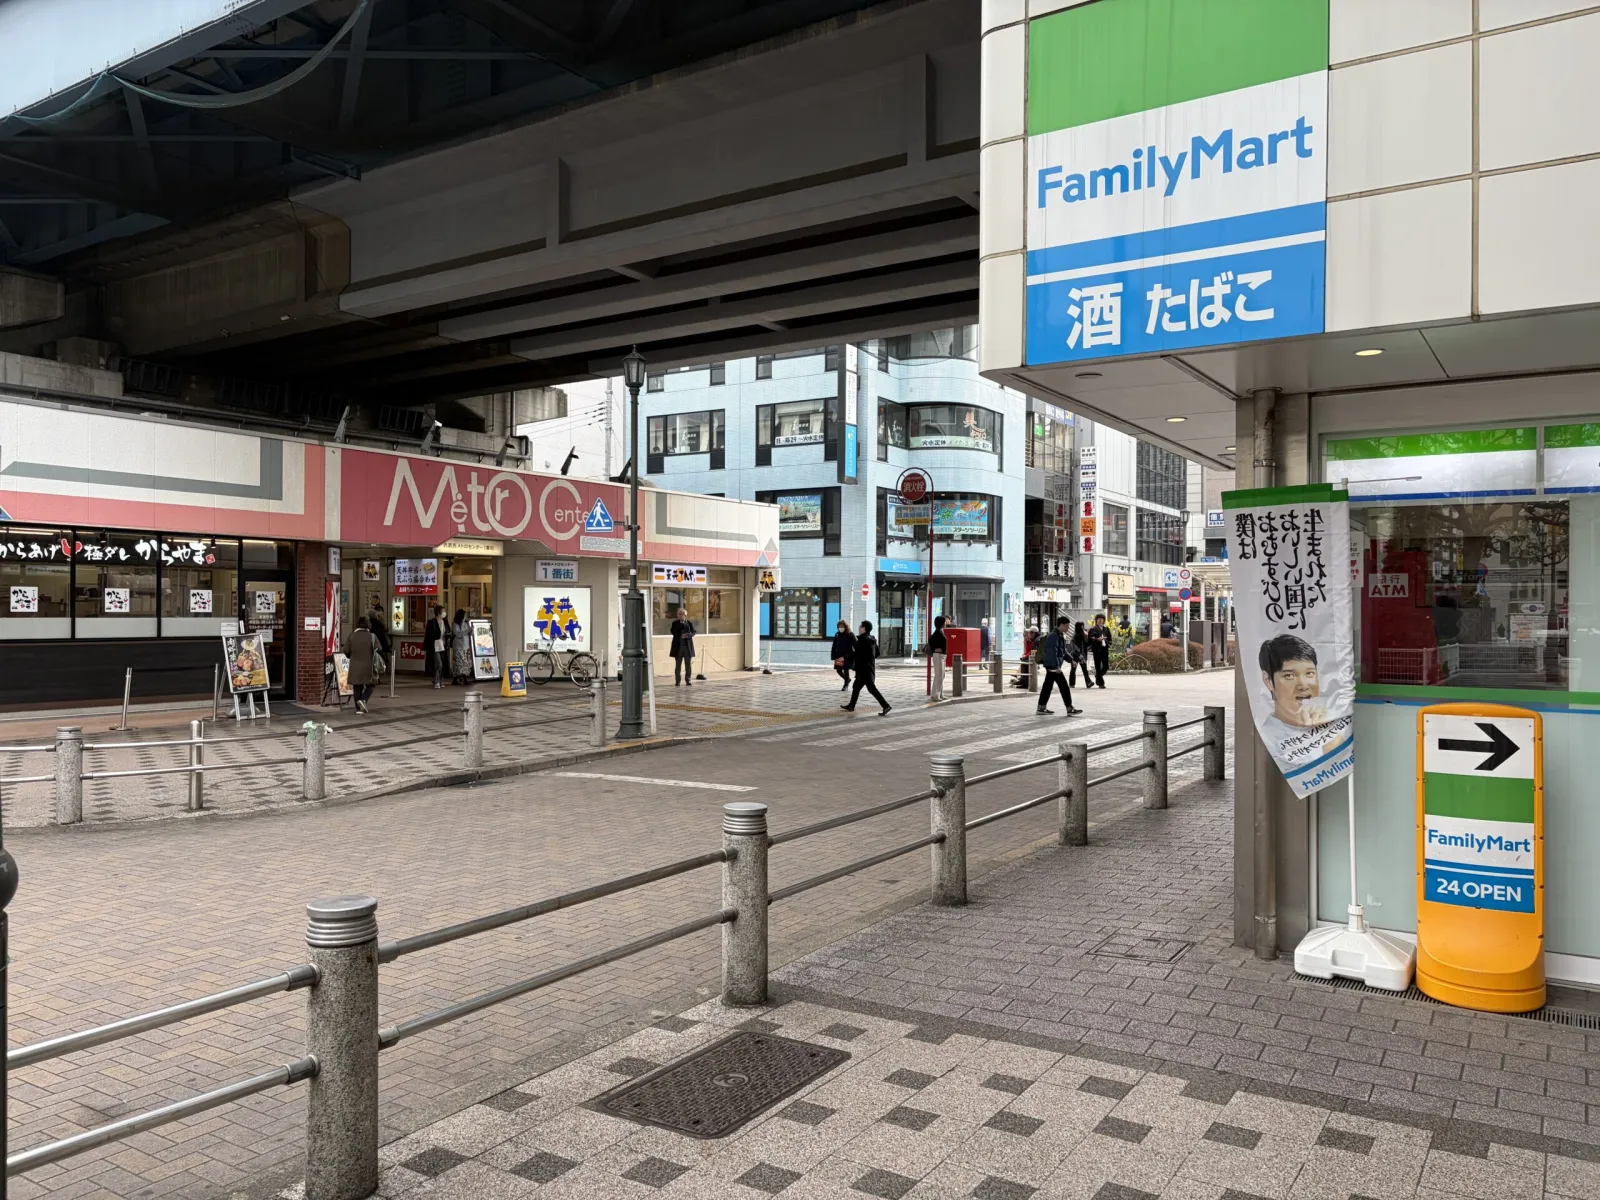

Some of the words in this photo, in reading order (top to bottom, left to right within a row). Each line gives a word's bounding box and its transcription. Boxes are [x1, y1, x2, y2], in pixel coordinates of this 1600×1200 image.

[1037, 115, 1314, 209] FamilyMart
[1066, 281, 1123, 350] 酒
[1145, 269, 1275, 335] たばこ
[903, 481, 925, 493] 消火栓
[539, 478, 592, 541] Cente
[0, 541, 61, 560] からあげ
[84, 545, 131, 561] 極ダレ
[135, 539, 207, 566] からやま
[542, 567, 574, 580] 1番街
[1371, 584, 1407, 596] ATM
[543, 596, 574, 615] 天丼
[1428, 829, 1531, 853] FamilyMart
[1436, 878, 1461, 896] 24
[1462, 882, 1522, 902] OPEN
